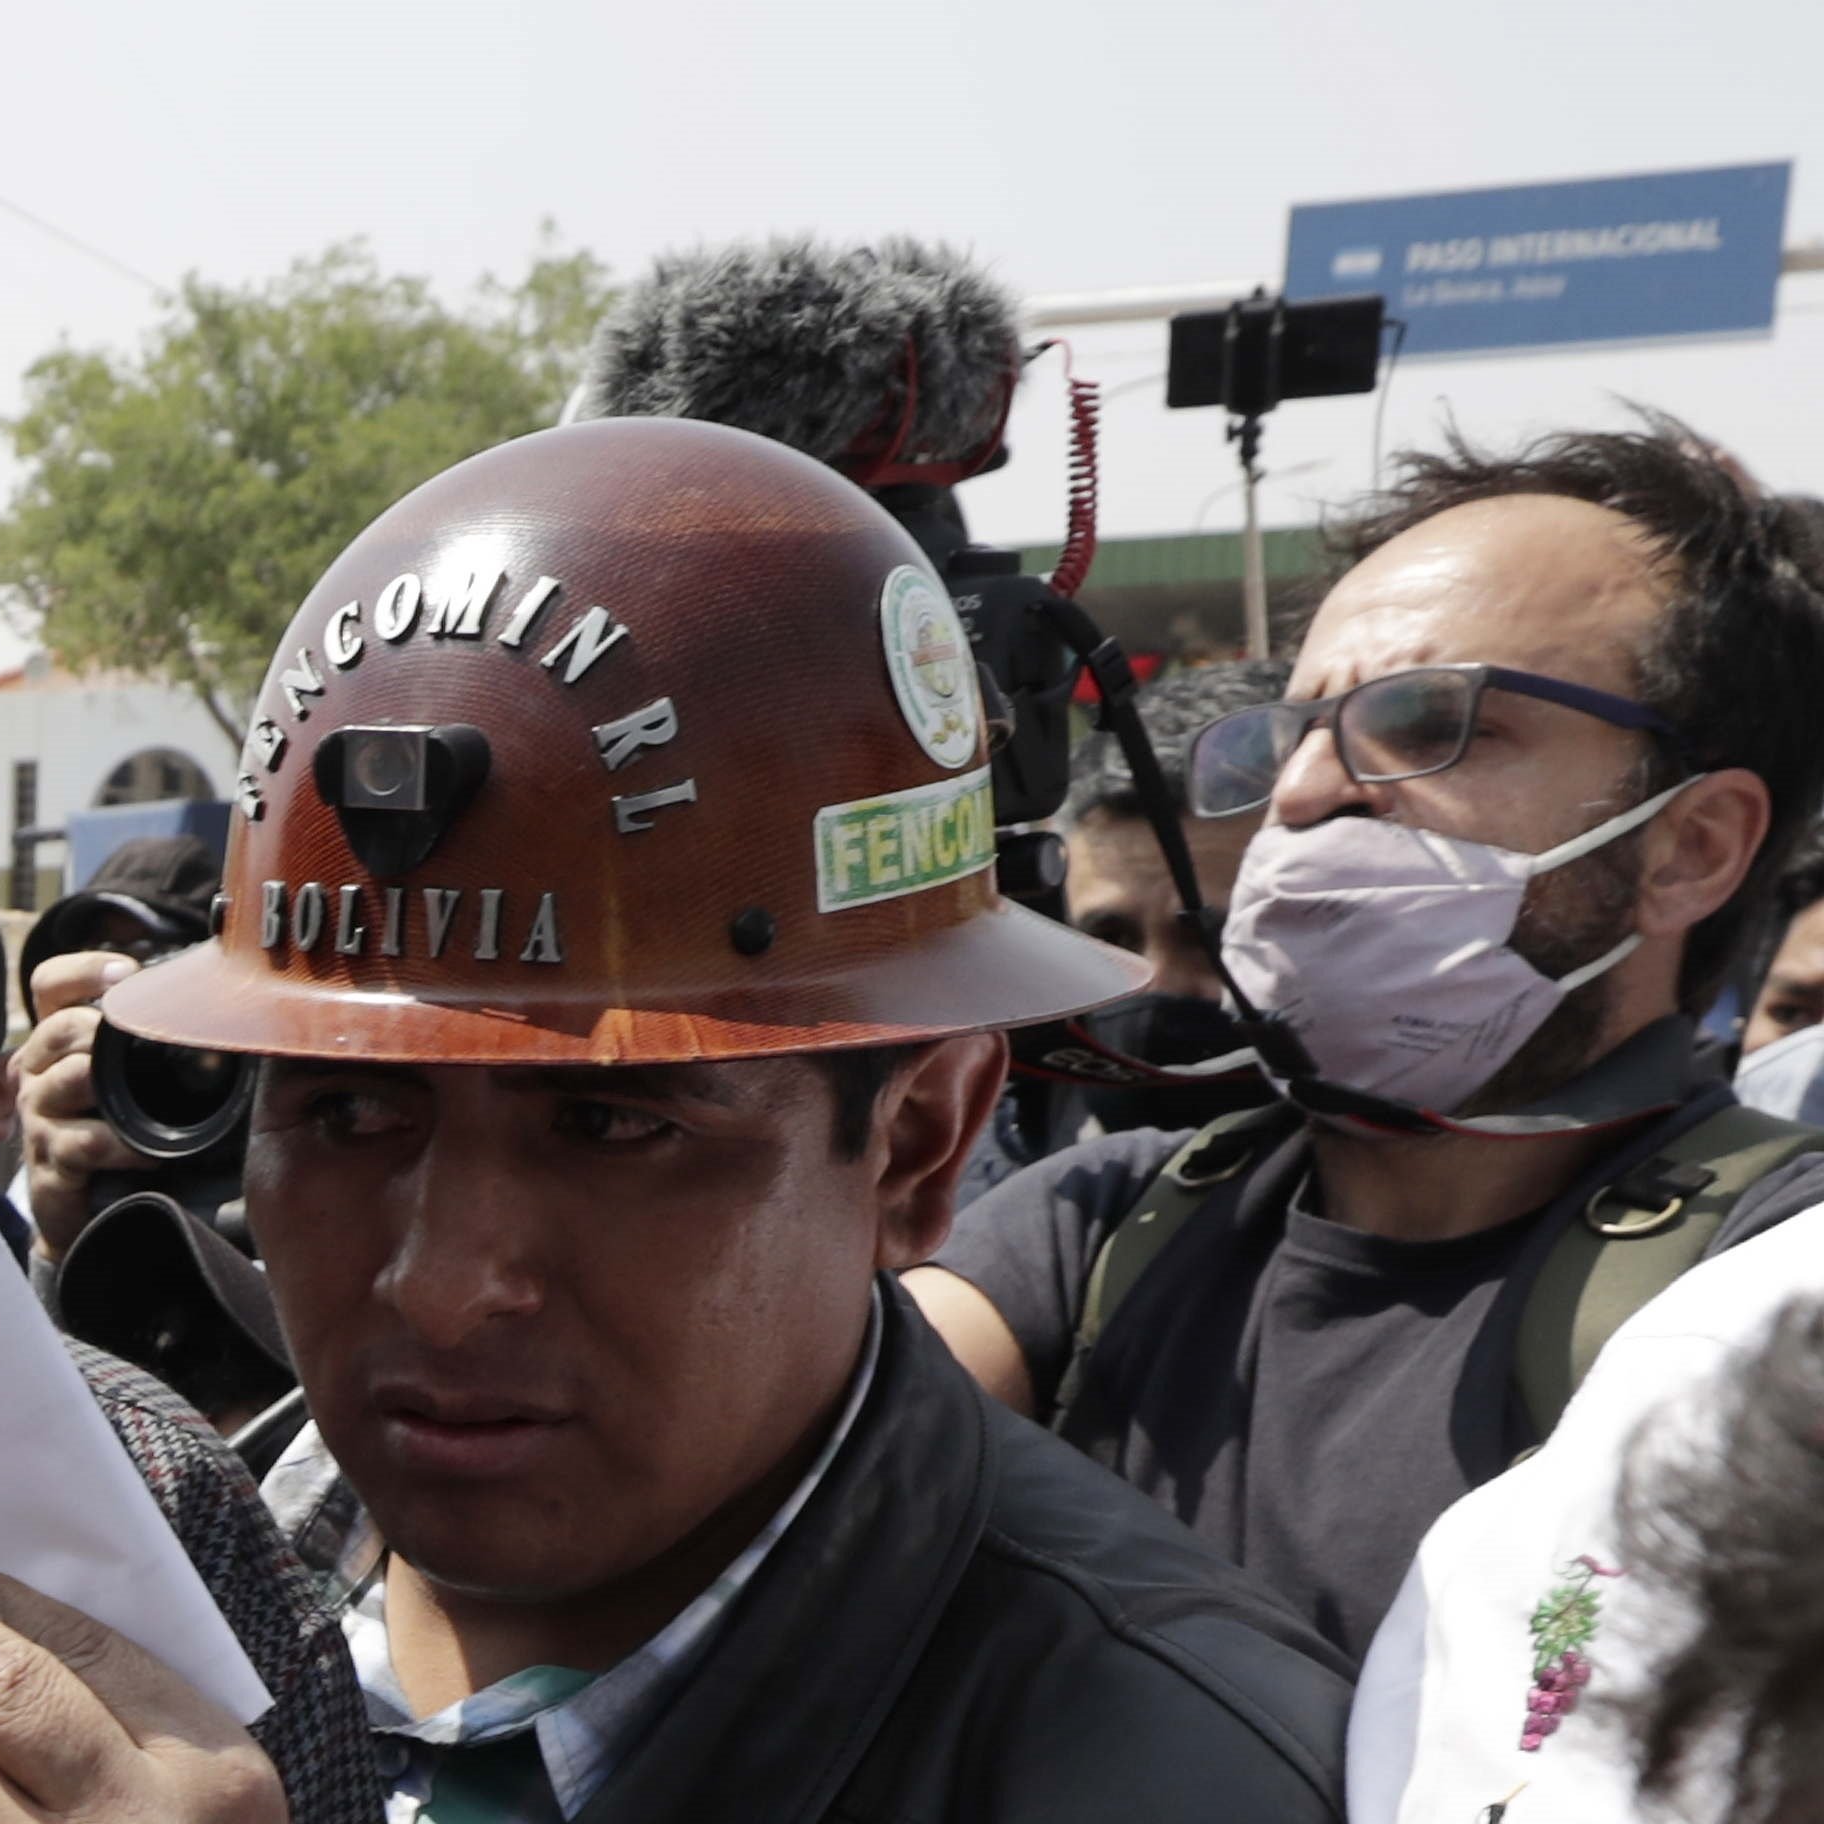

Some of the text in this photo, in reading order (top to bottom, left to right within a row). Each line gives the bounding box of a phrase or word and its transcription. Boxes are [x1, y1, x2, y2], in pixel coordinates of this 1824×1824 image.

[1405, 219, 1721, 273] PASO INTERNACIONAL
[261, 880, 562, 963] BOLIVIA
